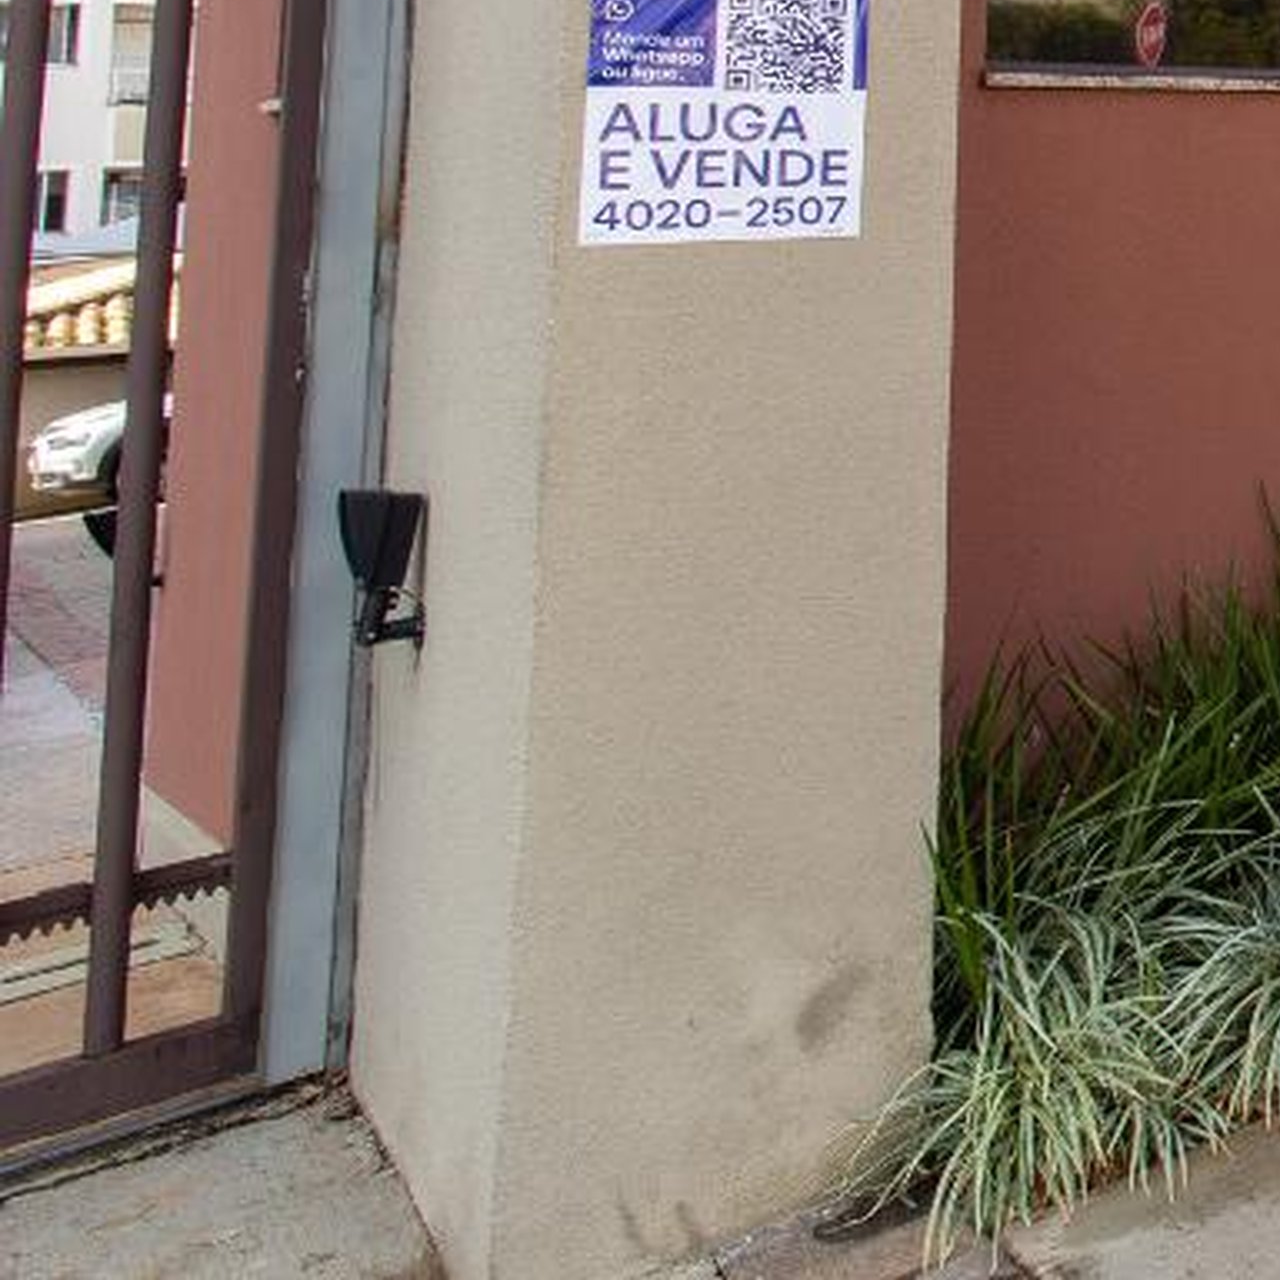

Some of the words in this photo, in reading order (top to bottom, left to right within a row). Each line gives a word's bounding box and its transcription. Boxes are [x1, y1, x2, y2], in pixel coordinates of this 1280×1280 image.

[600, 102, 807, 143] ALUGA
[600, 150, 631, 189] E
[650, 149, 849, 188] VENDE
[593, 195, 847, 231] 4020-2507
